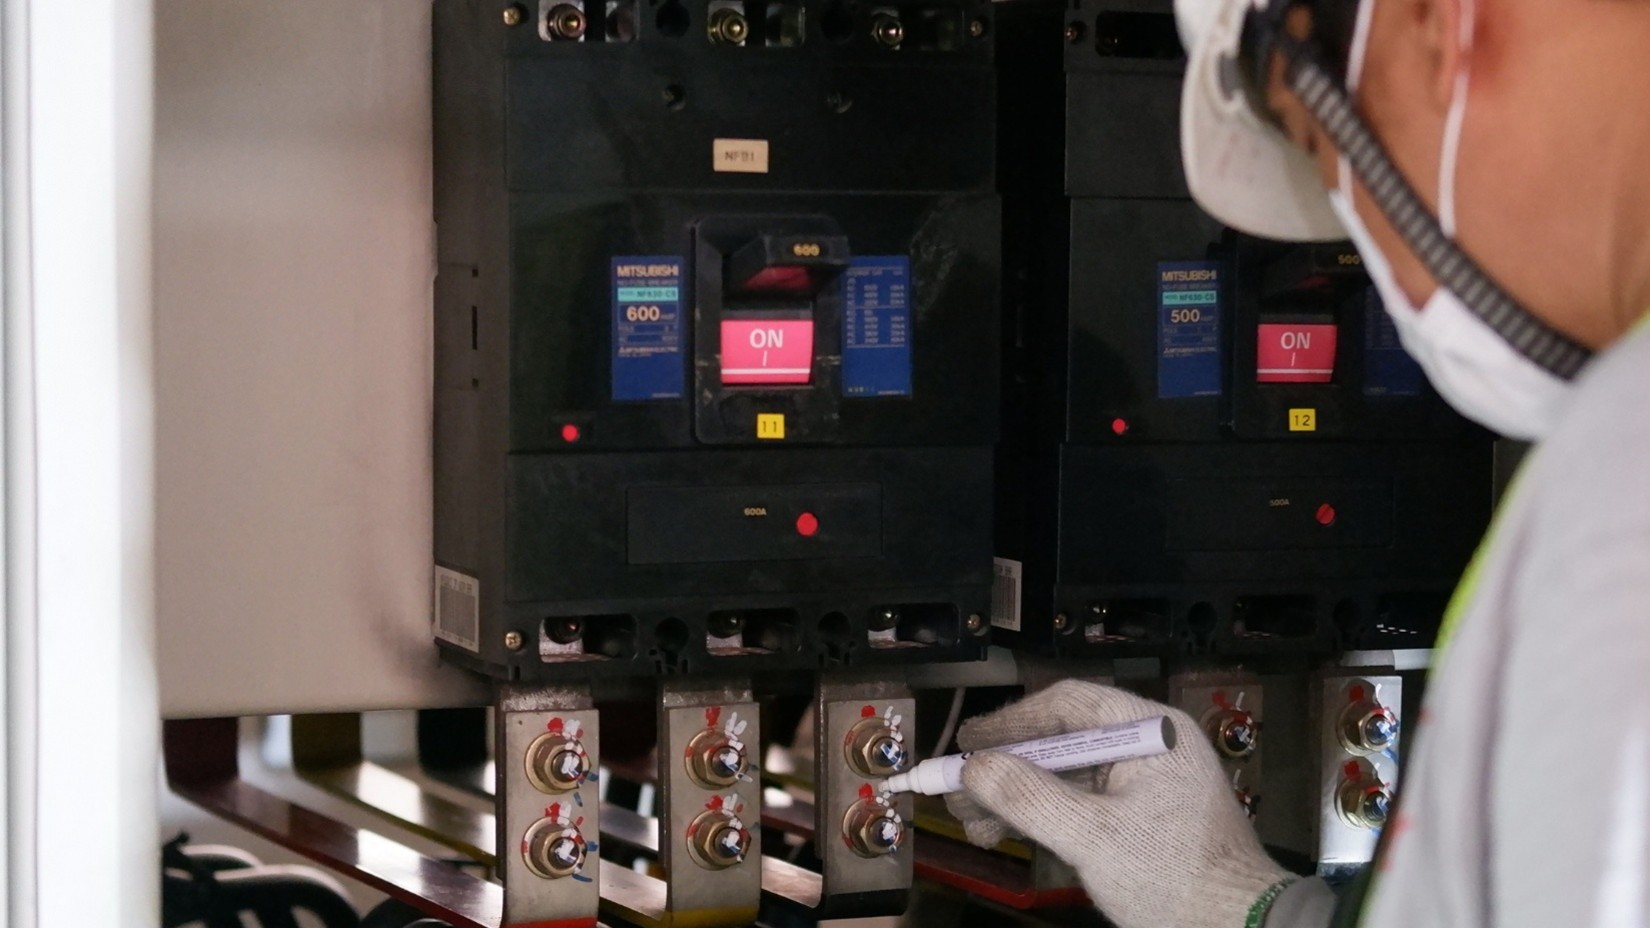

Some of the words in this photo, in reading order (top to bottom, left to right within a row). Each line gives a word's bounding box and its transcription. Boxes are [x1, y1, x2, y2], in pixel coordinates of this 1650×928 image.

[724, 151, 755, 162] NFB1
[793, 243, 820, 256] 600
[616, 265, 679, 278] MITSUBISHI
[1162, 270, 1217, 281] MITSUBISHI
[626, 305, 660, 322] 600
[1171, 308, 1201, 323] 500
[749, 328, 784, 349] ON
[1280, 331, 1311, 350] ON
[762, 420, 777, 433] 11
[1294, 414, 1311, 427] 12
[744, 507, 767, 516] 600A
